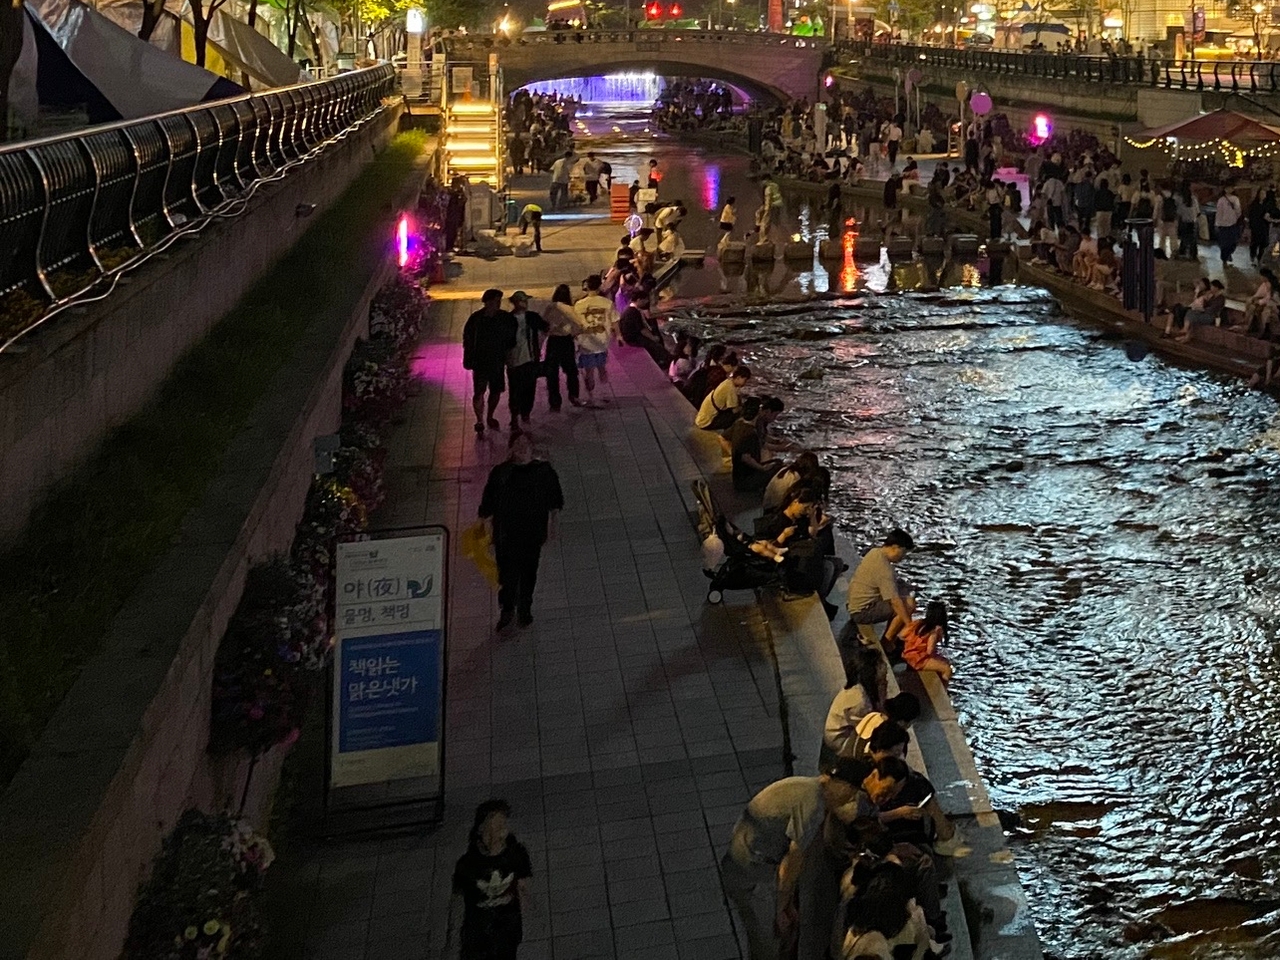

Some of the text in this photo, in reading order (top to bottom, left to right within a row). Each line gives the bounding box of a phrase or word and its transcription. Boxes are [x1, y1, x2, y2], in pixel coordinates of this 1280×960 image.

[381, 604, 411, 620] 책멍
[349, 655, 401, 677] 책읽는
[348, 675, 419, 702] 맑은냇가
